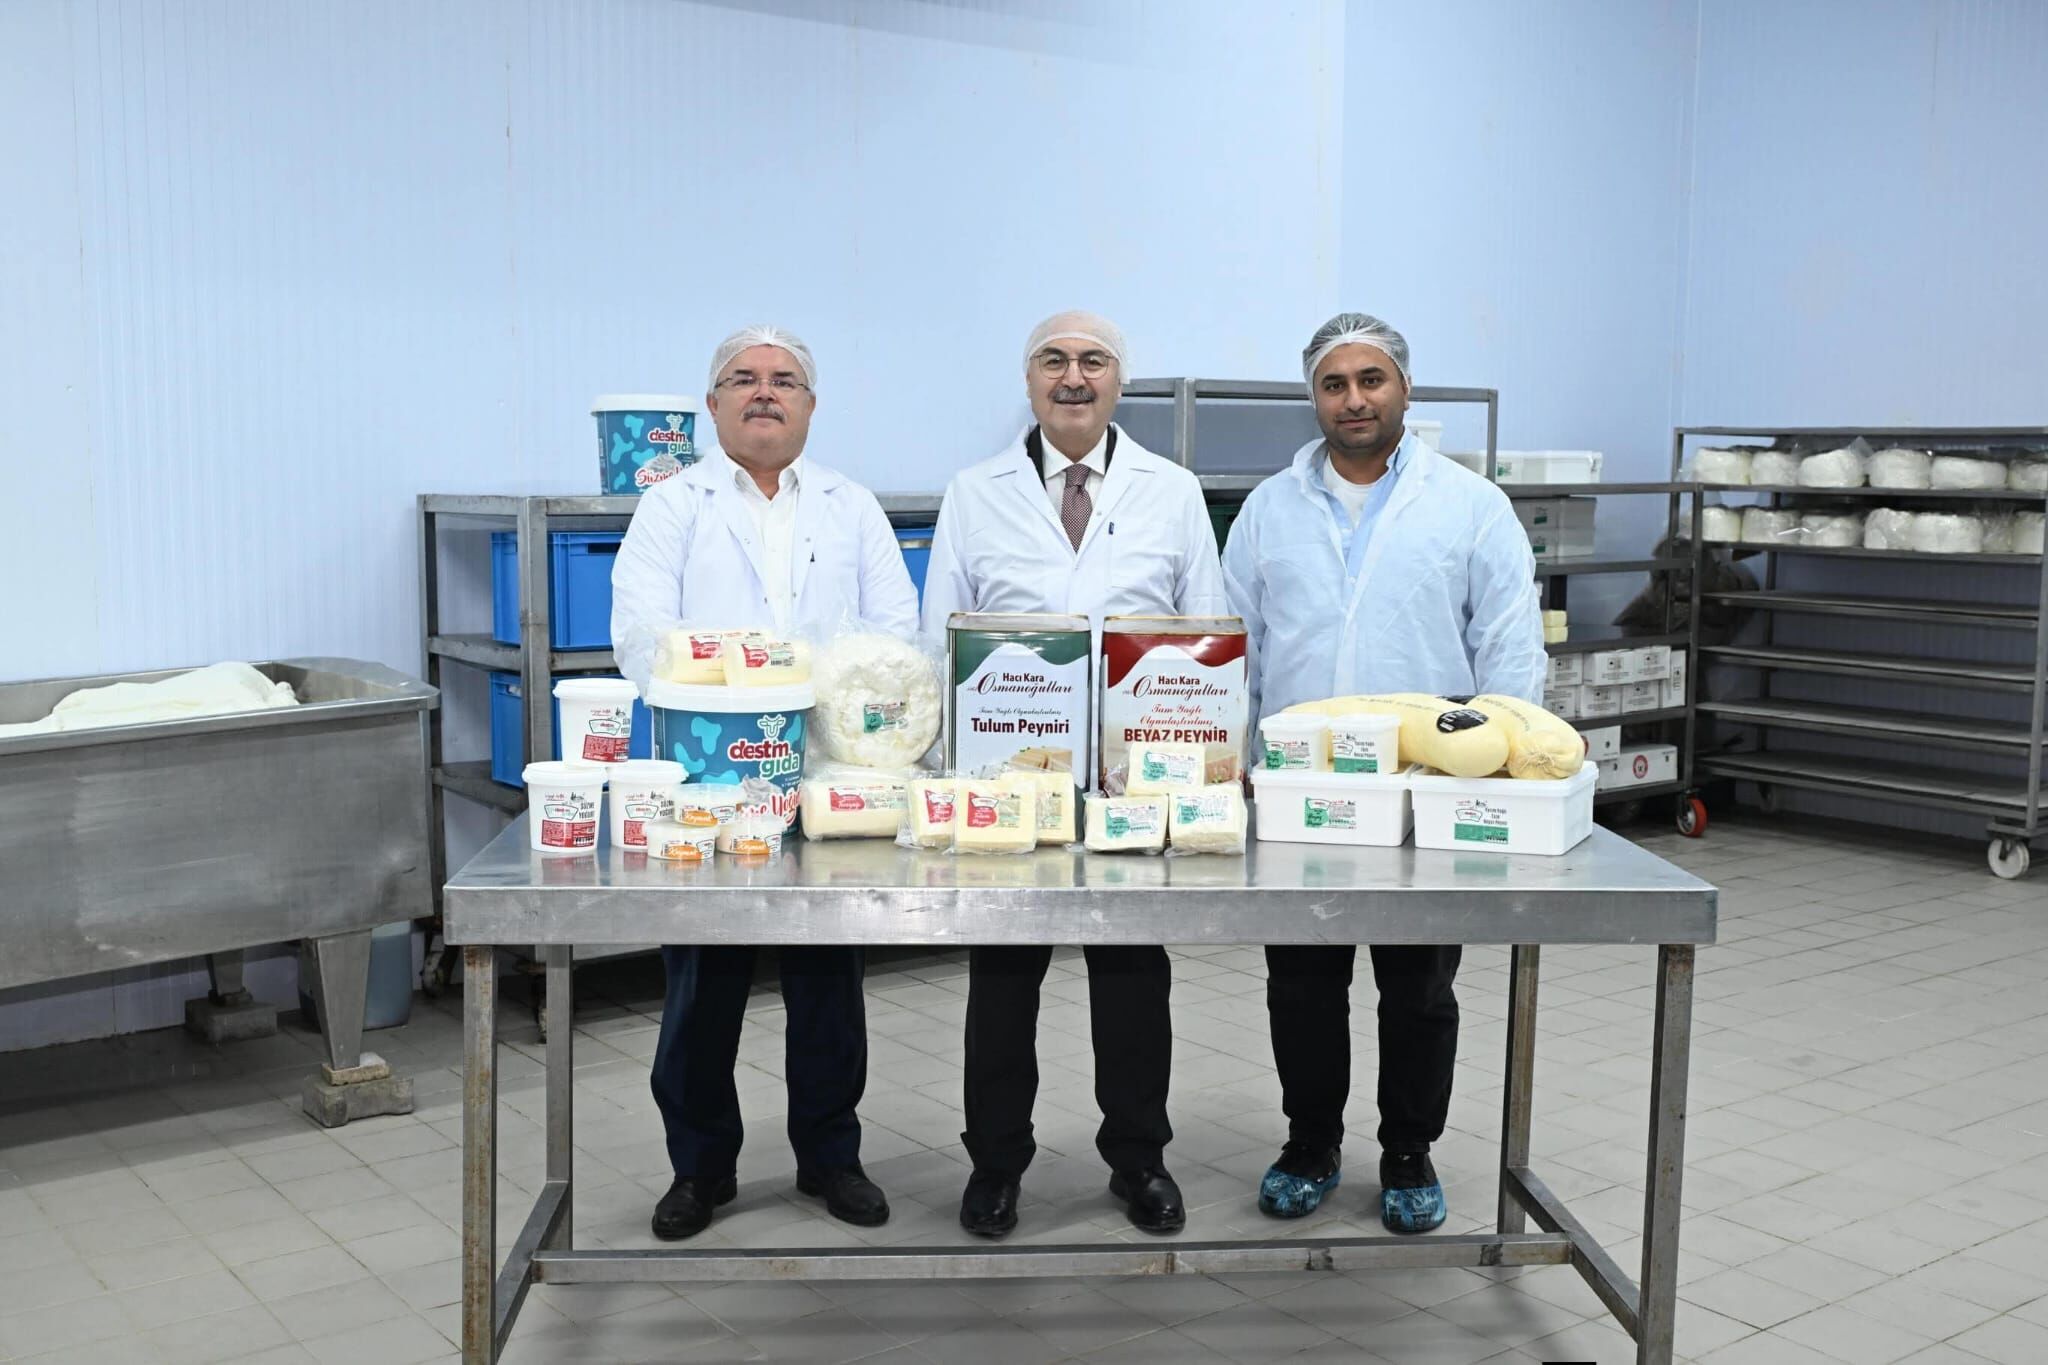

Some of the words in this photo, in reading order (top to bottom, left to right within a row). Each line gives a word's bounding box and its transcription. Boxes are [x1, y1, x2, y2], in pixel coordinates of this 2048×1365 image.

[977, 672, 1073, 698] Osmanoğulları
[1002, 672, 1022, 682] Hacı
[1023, 673, 1044, 682] Kara
[1158, 675, 1178, 685] Hacı
[1179, 676, 1200, 685] Kara
[1133, 675, 1228, 701] Osmanoğulları
[971, 718, 1015, 733] Tulum
[1018, 719, 1070, 737] Peyniri
[1124, 728, 1171, 742] BEYAZ
[1174, 726, 1228, 743] PEYNİR
[761, 752, 800, 778] gıda
